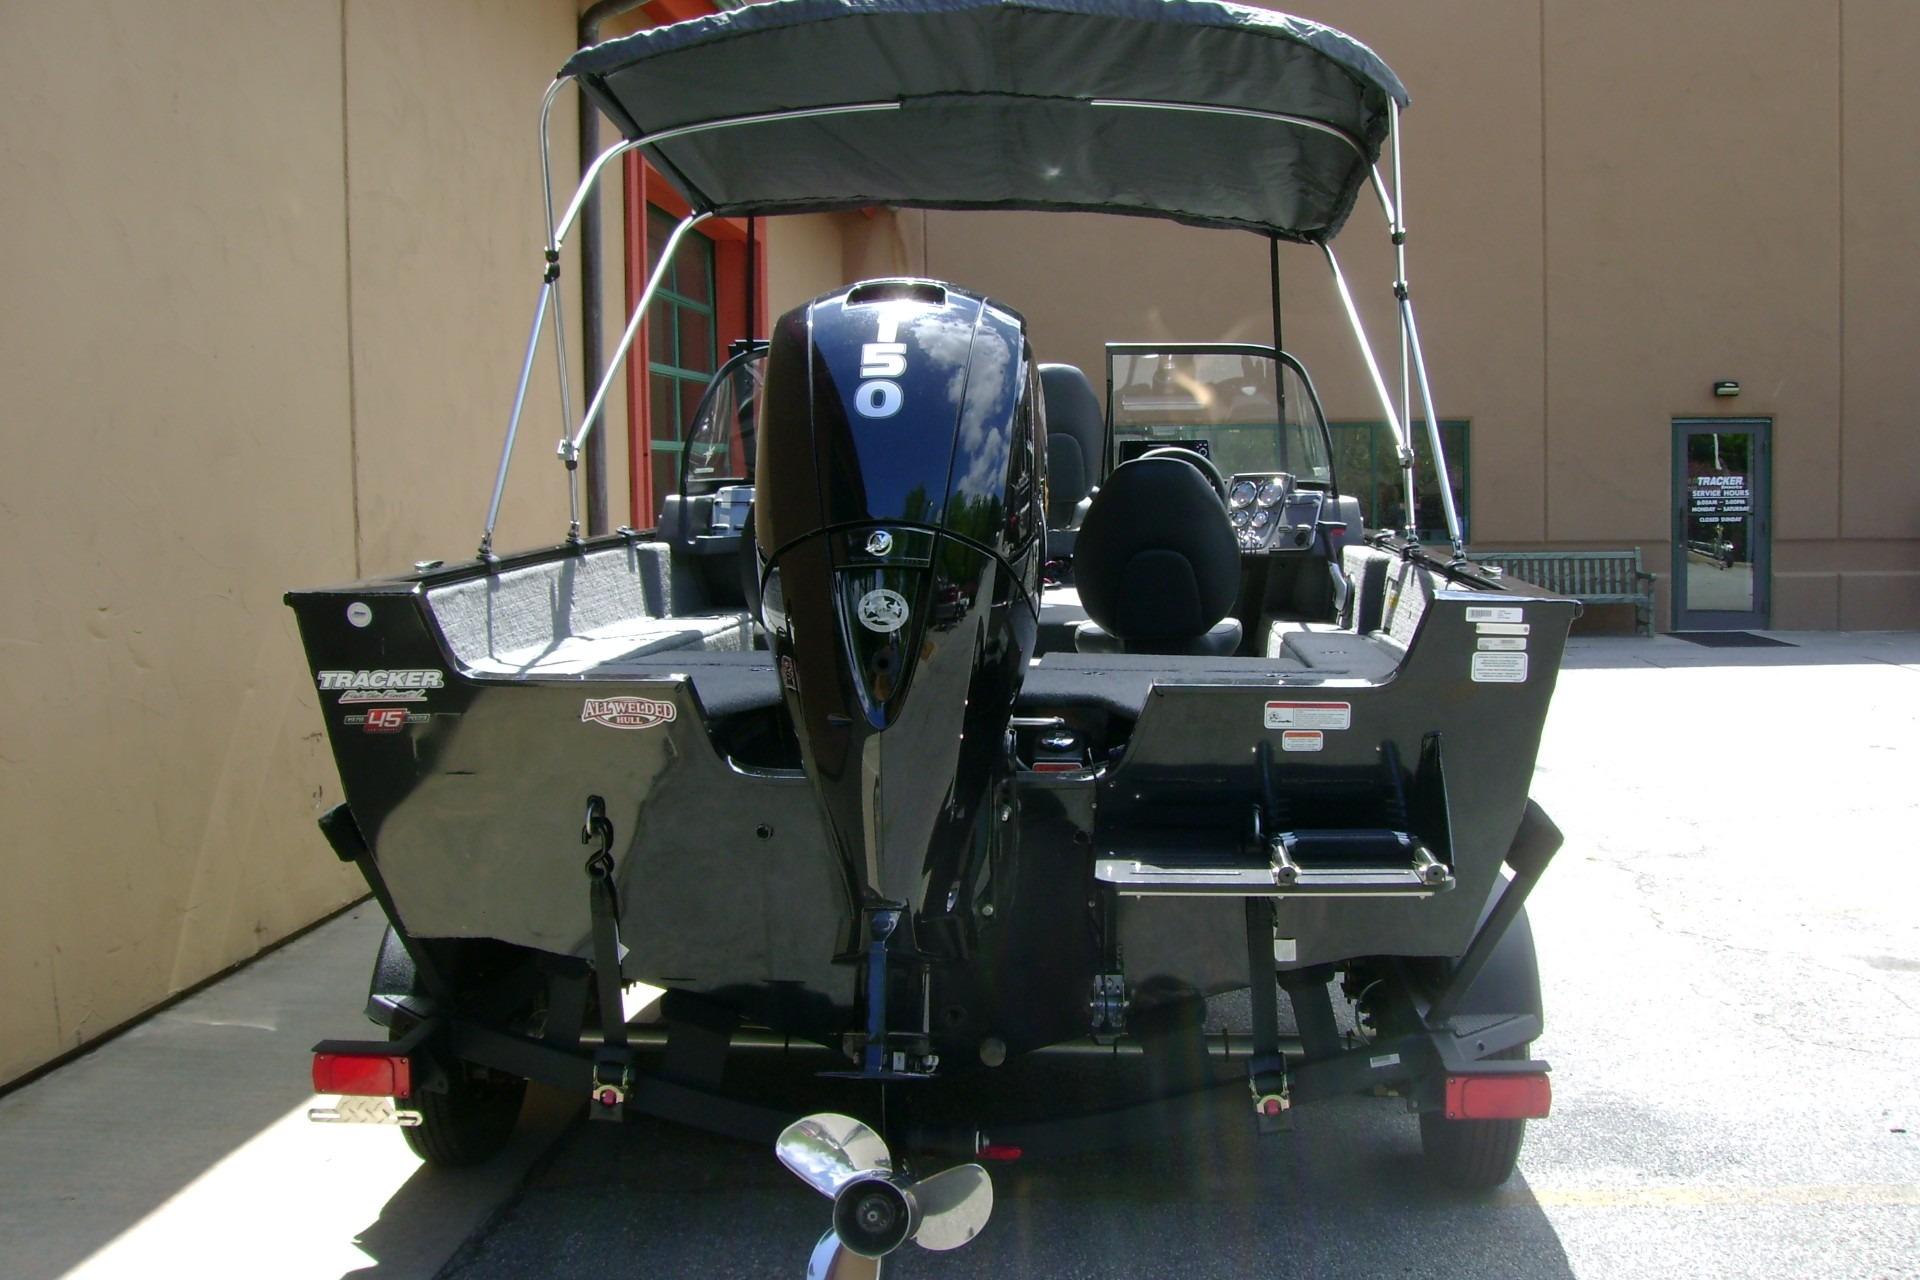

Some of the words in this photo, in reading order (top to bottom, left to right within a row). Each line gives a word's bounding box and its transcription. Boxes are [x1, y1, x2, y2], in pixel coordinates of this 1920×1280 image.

[1697, 476, 1743, 485] TRACKER
[319, 670, 443, 689] TRACKER
[584, 700, 613, 719] ALL
[612, 700, 674, 719] WELDED
[367, 711, 402, 727] 45
[616, 716, 642, 724] HULL
